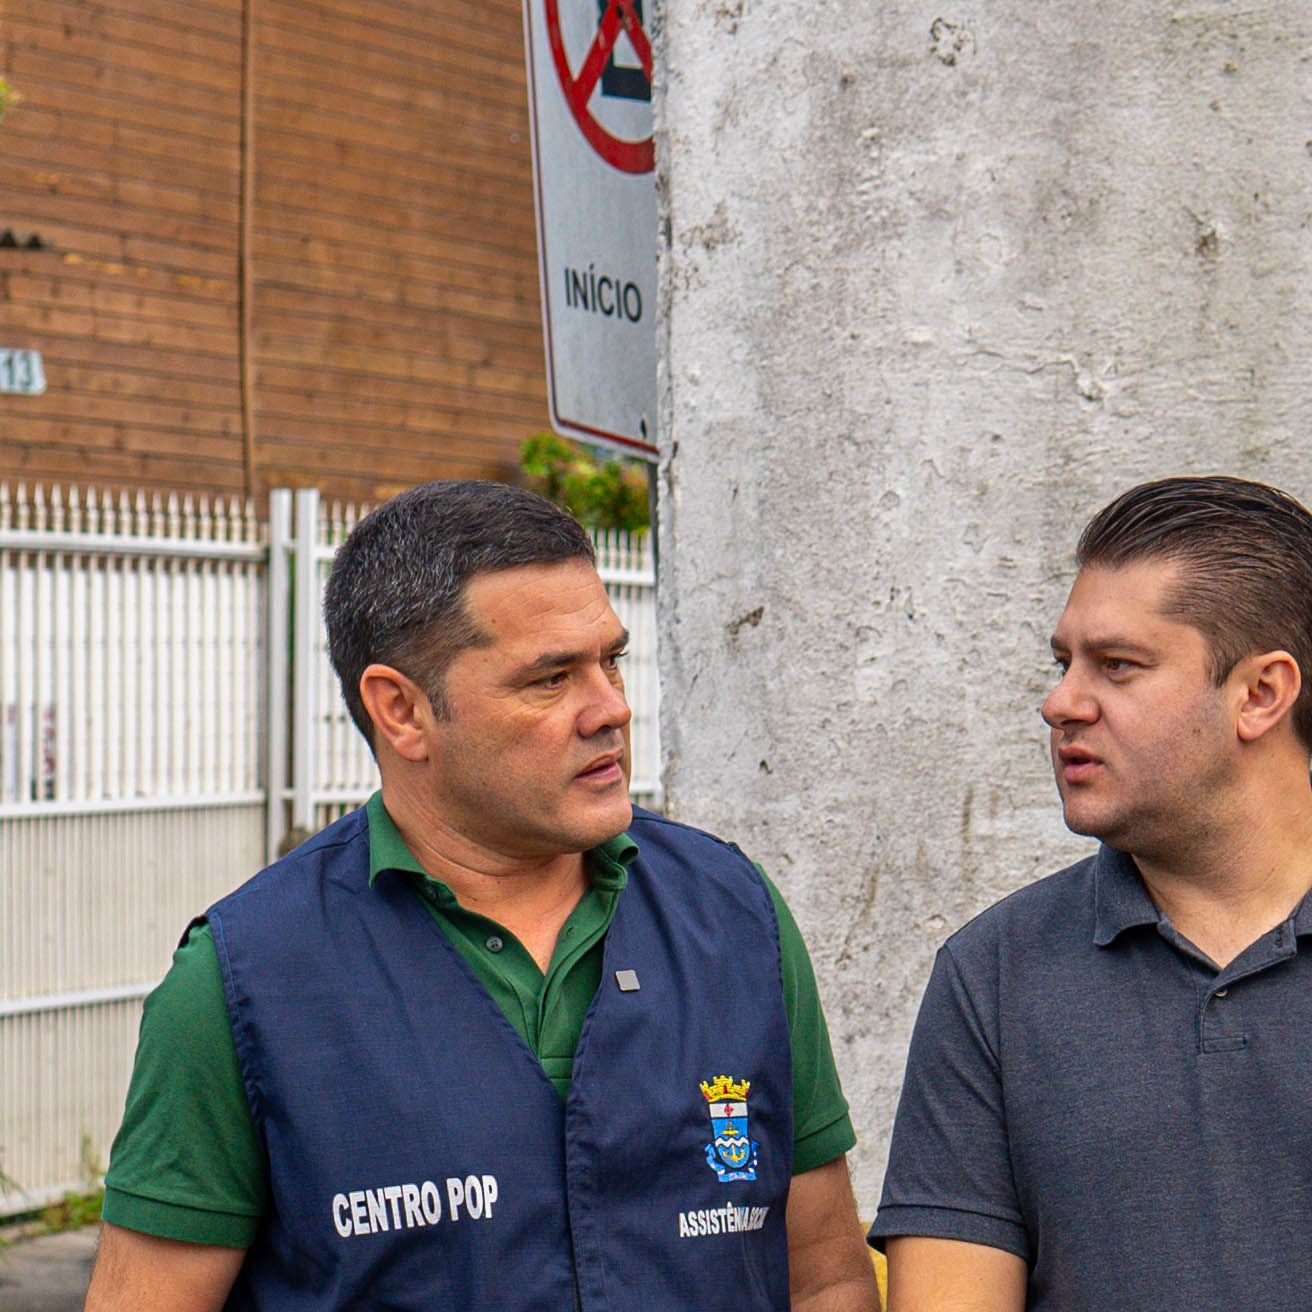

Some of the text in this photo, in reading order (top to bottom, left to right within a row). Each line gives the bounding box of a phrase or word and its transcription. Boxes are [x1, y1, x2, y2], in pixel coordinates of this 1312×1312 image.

[564, 262, 643, 324] INÍCIO
[332, 1174, 499, 1238] CENTRO POP
